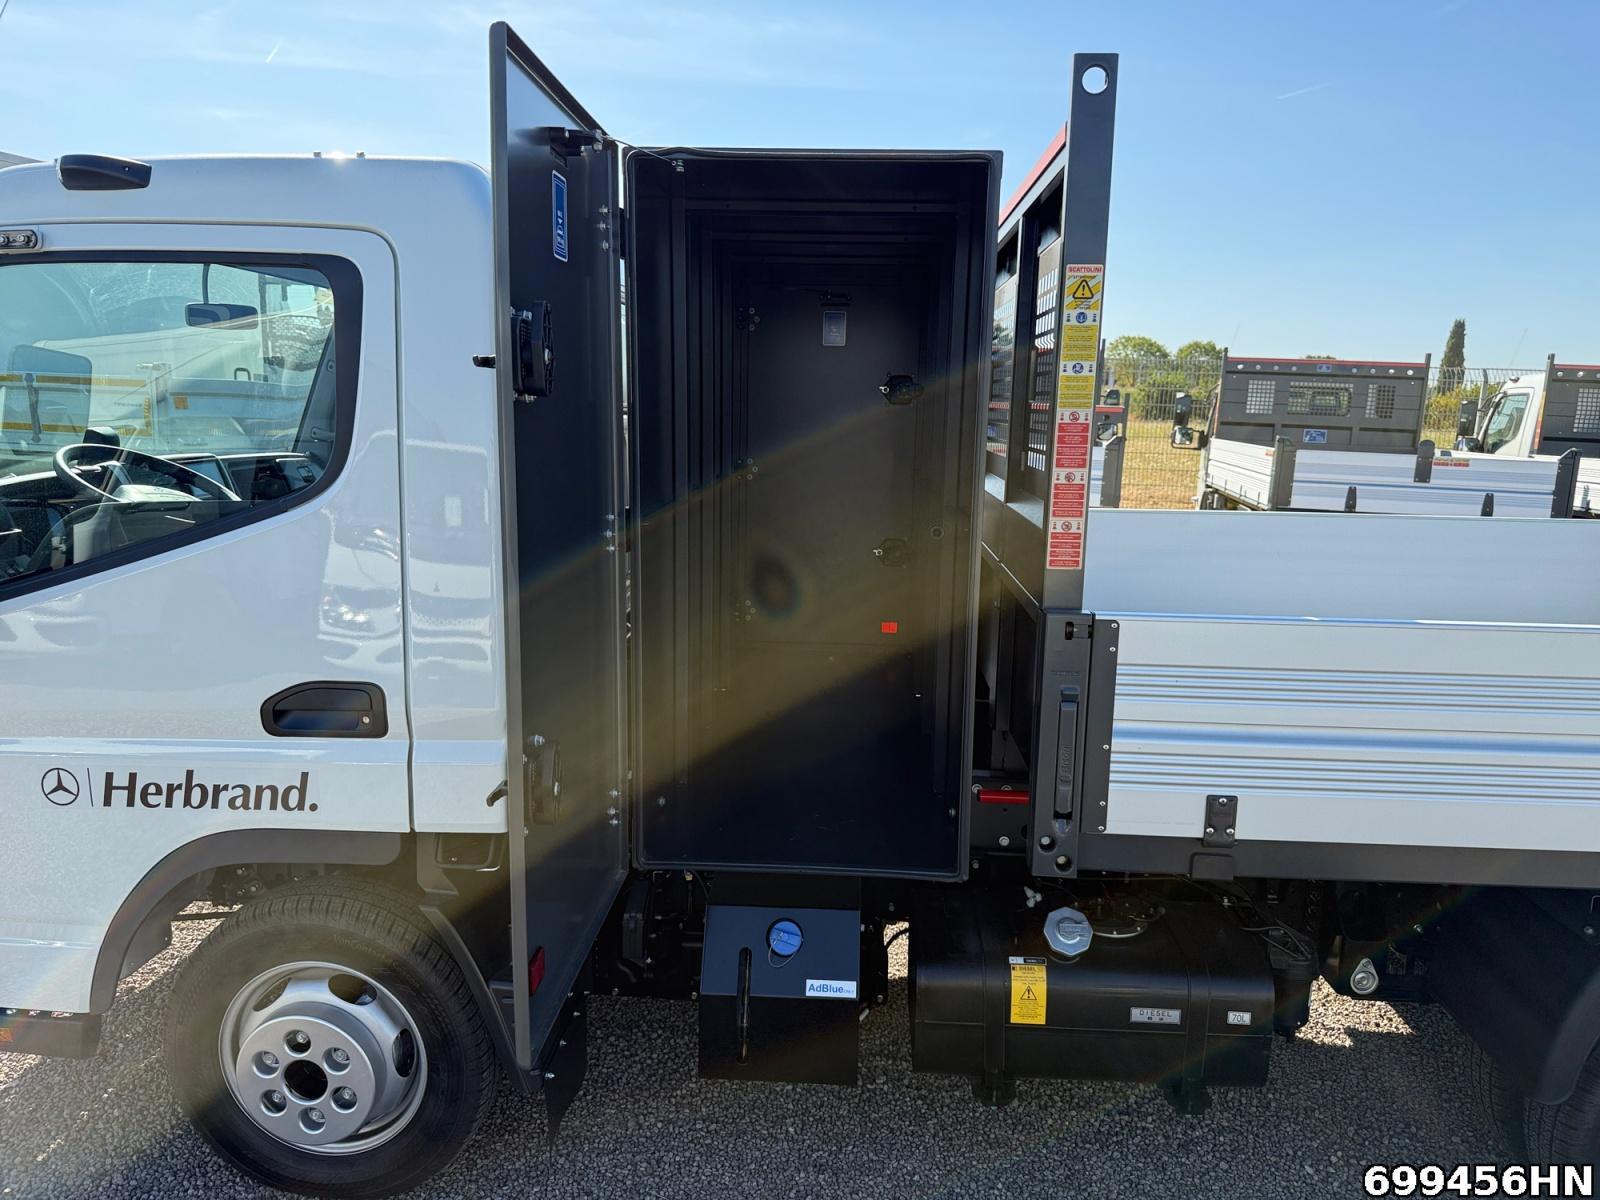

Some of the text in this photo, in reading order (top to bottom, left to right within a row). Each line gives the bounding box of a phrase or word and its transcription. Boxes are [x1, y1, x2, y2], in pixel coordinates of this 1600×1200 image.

[103, 769, 319, 812] Herbrand.
[808, 984, 844, 993] AdBlue
[1139, 1009, 1172, 1017] DIESEL
[1232, 1014, 1246, 1022] 70L
